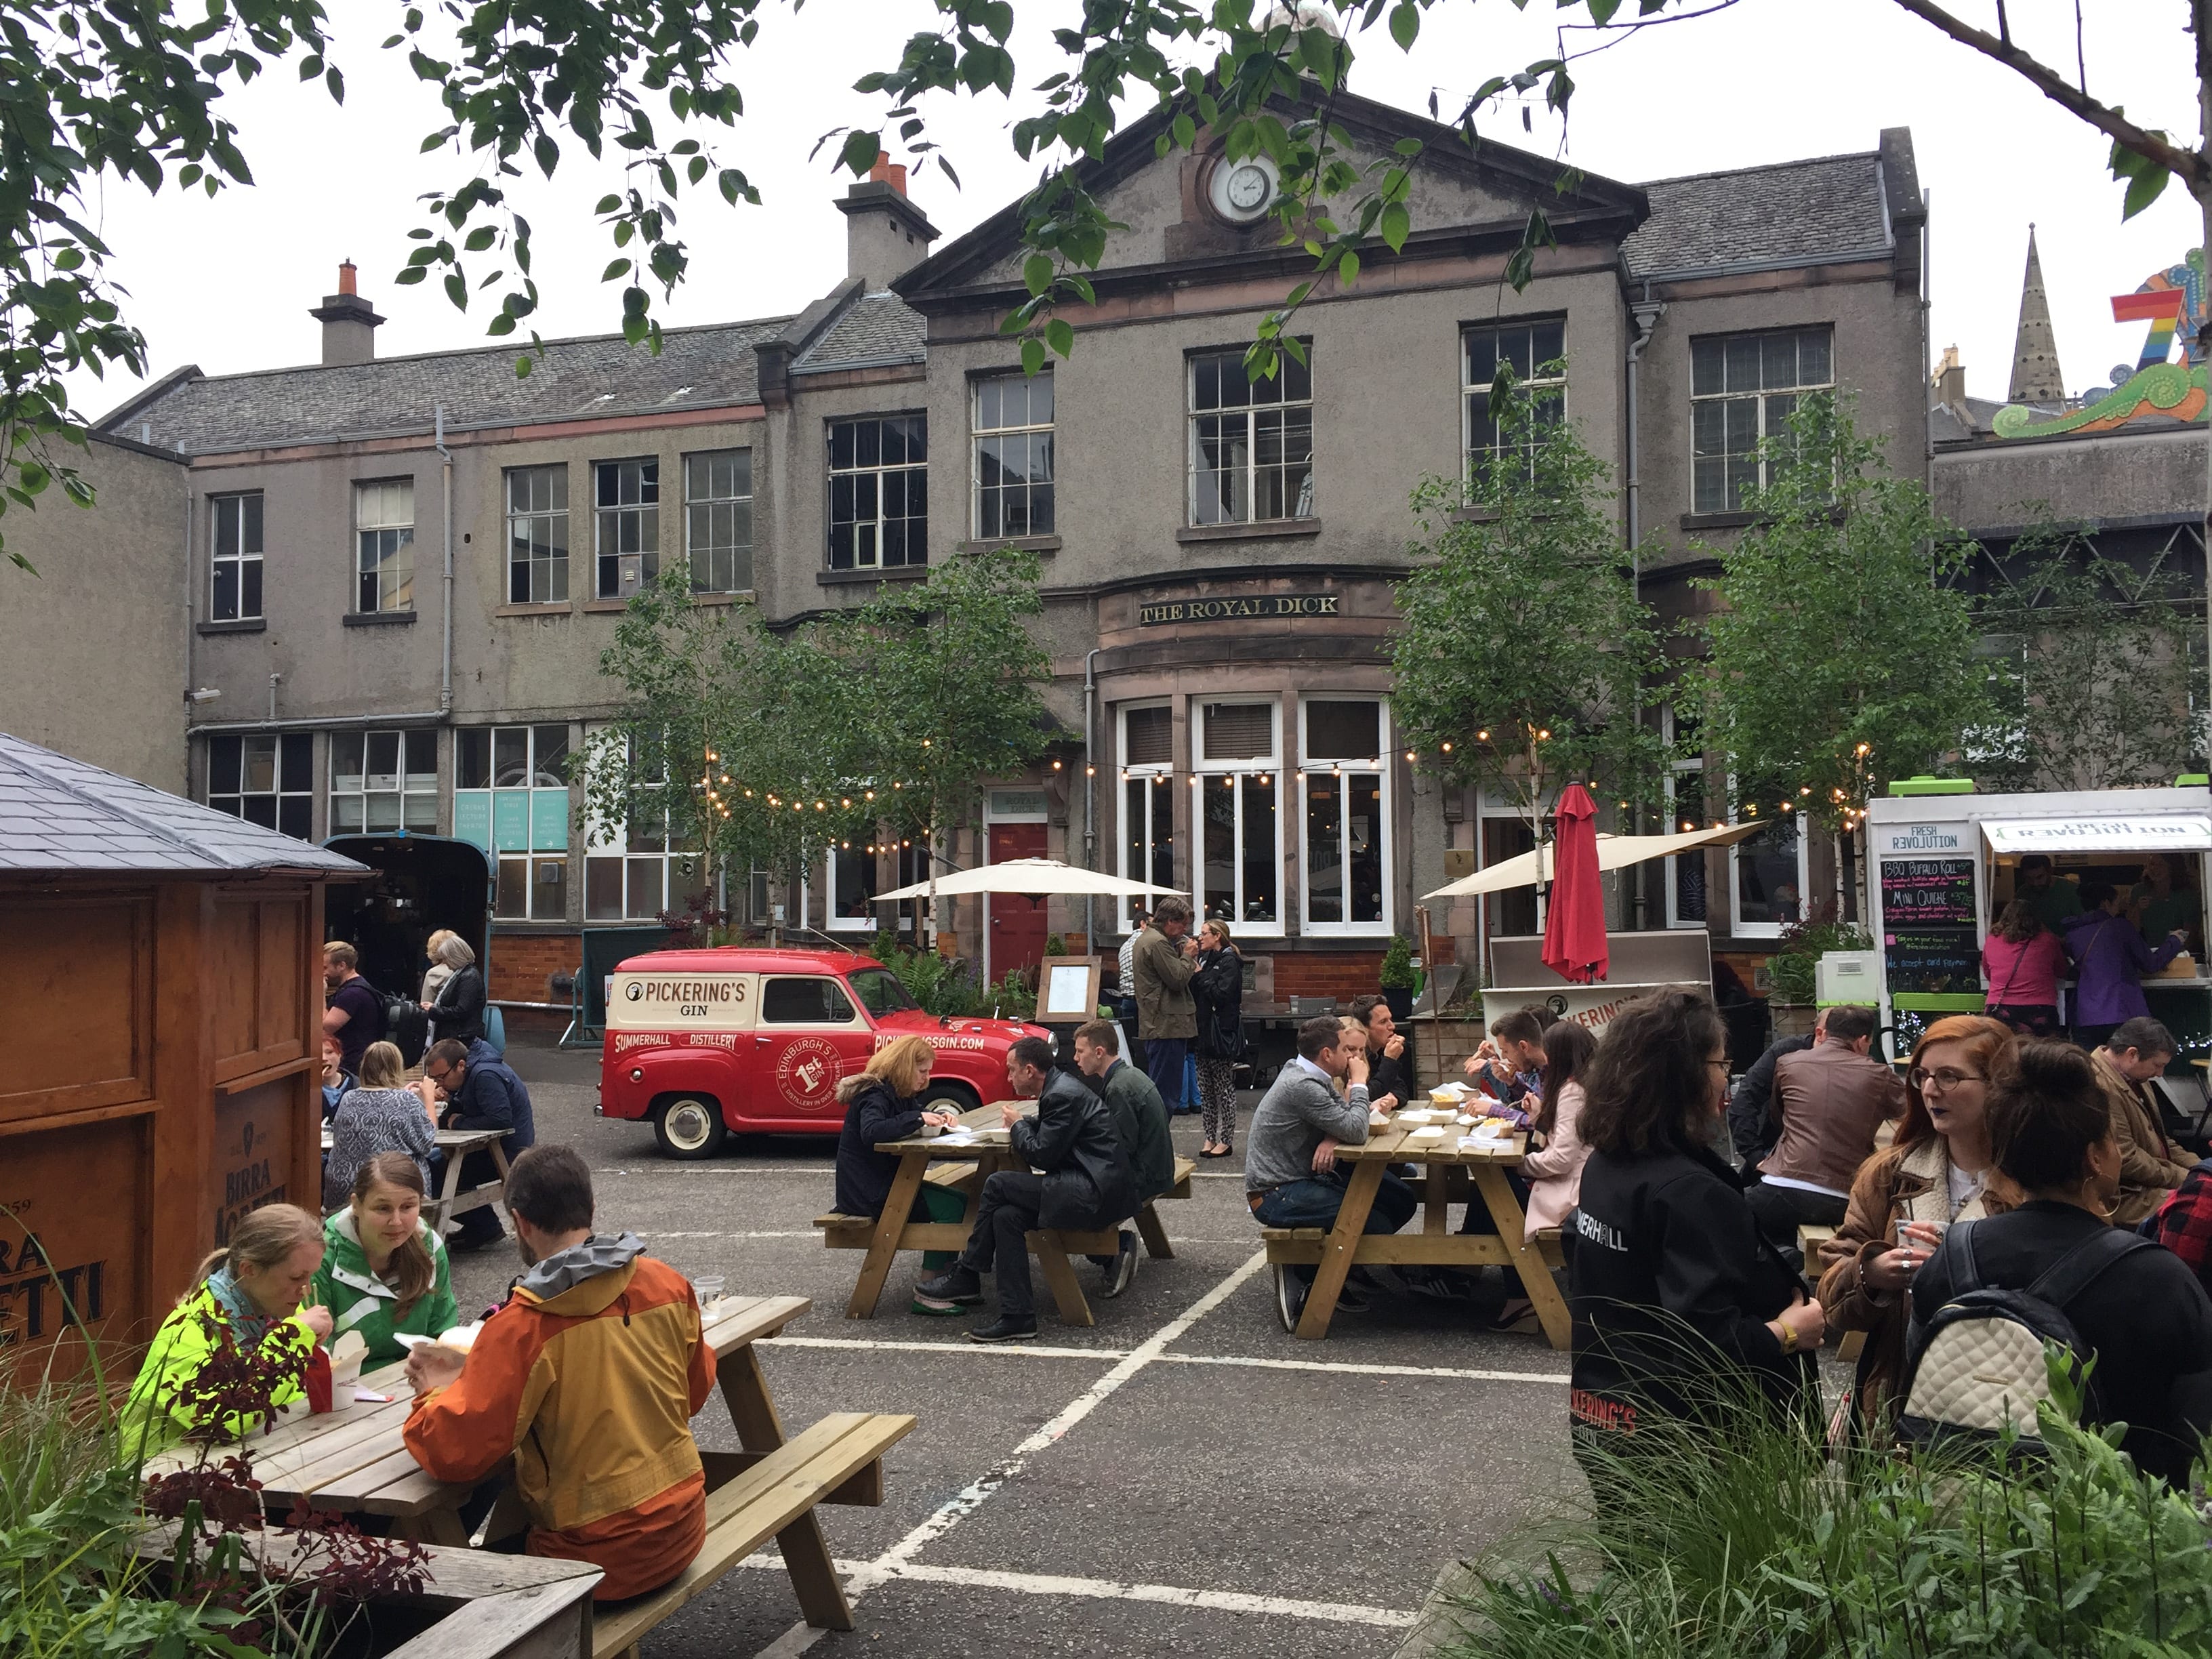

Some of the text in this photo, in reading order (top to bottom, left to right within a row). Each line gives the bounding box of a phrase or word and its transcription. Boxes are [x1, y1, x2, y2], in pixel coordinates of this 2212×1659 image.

[1140, 597, 1338, 623] THE ROYAL DICK
[1006, 796, 1040, 804] ROYAL
[1911, 825, 1938, 836] FRESH
[2018, 826, 2186, 837] REVOLUTION
[1892, 835, 1958, 849] REVOLUTION
[1884, 861, 1905, 878] BBQ
[1908, 861, 1938, 876] BUFFALO
[1940, 859, 1957, 876] ROLL
[1893, 890, 1913, 907] MINI
[1917, 889, 1948, 907] QUICHE
[1900, 956, 1925, 968] accept
[1926, 957, 1941, 966] card
[646, 982, 746, 1002] PICKERING'S
[680, 1005, 709, 1016] GIN
[615, 1033, 737, 1052] SUMMERHALL DISTILLERY
[811, 1067, 825, 1082] GIN
[785, 1088, 813, 1106] DISTILLERY
[226, 1158, 271, 1209] BIRRA
